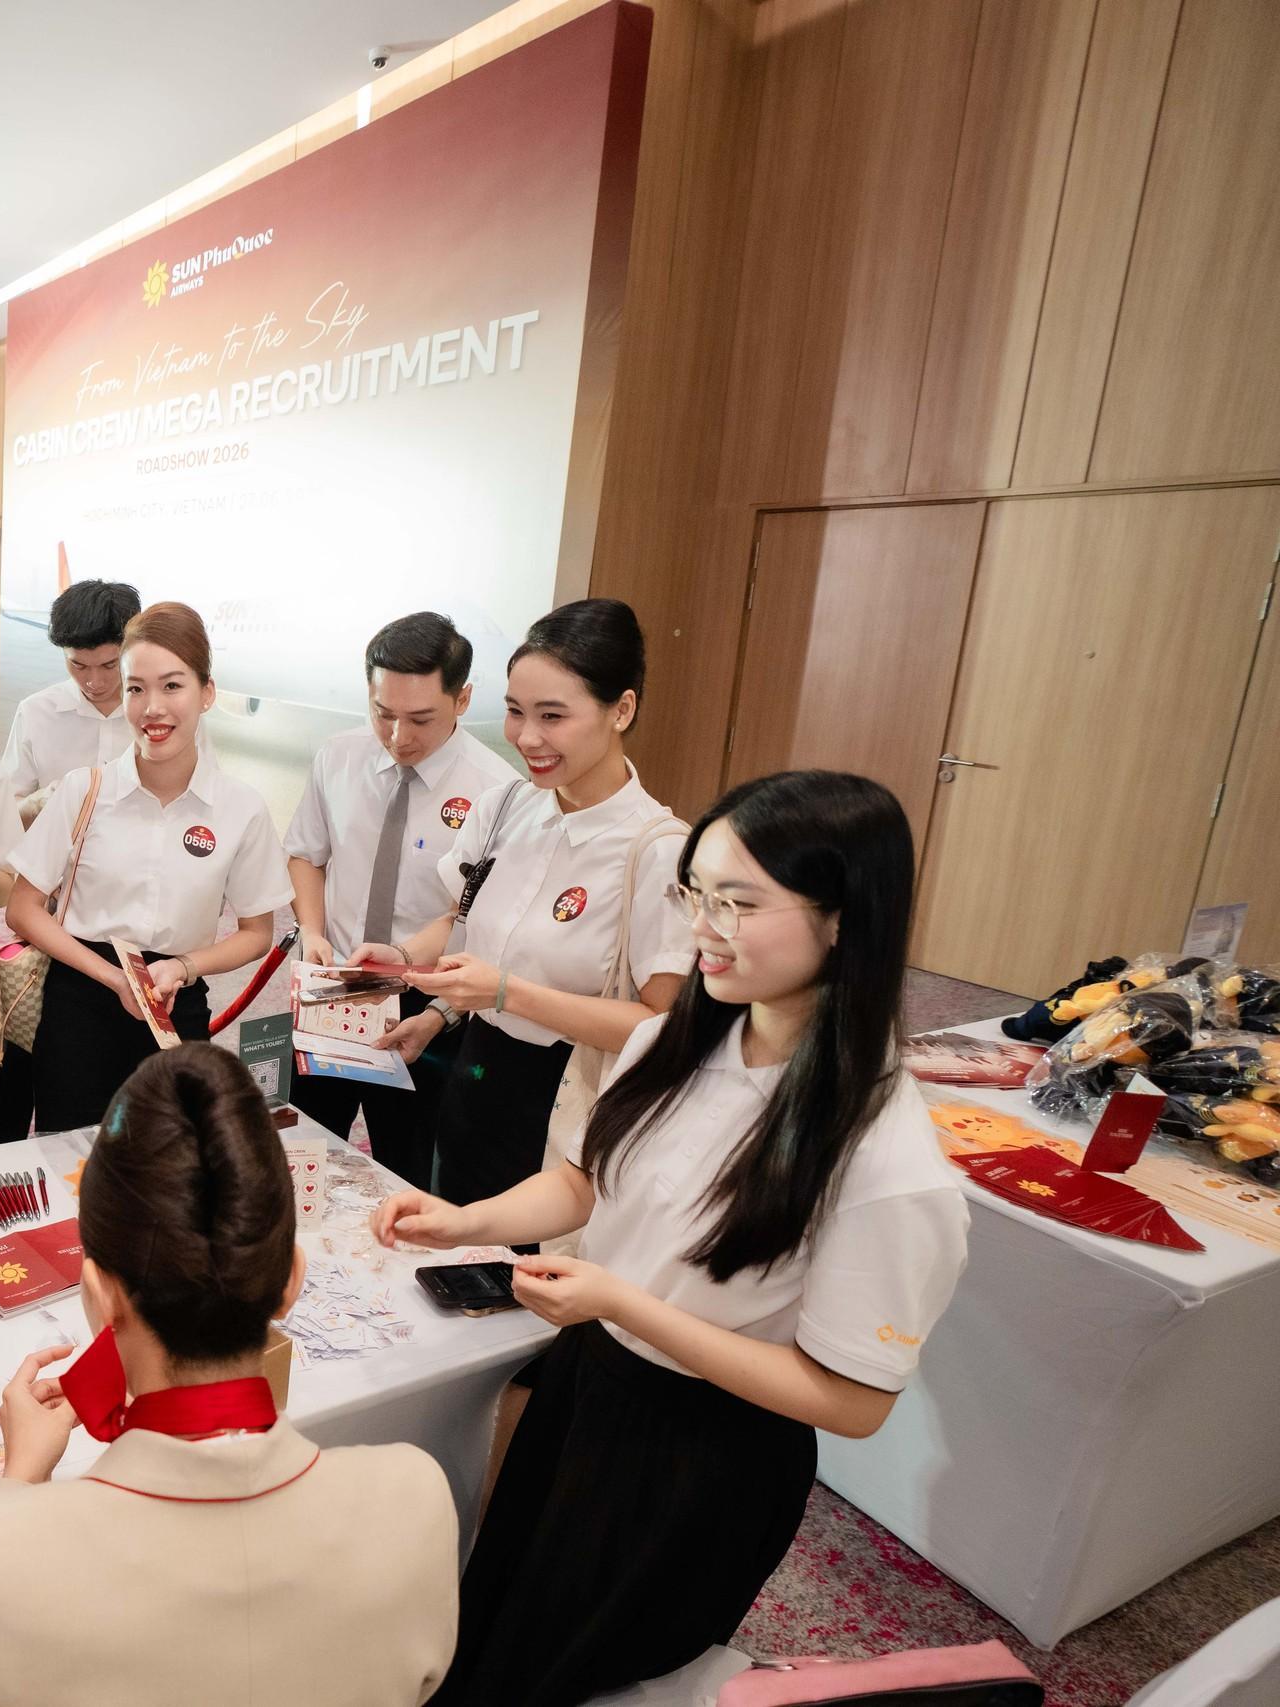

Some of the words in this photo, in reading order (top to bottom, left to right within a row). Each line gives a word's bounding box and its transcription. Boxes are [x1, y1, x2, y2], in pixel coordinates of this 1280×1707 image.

[171, 254, 201, 284] SUN
[202, 228, 274, 272] PhuQuoc
[170, 275, 204, 298] AIRWAYS
[76, 360, 126, 412] From
[133, 341, 214, 396] Vietnam
[216, 322, 246, 376] to
[246, 311, 291, 368] the
[299, 281, 369, 349] Sky
[12, 425, 69, 467] CABIN
[70, 408, 141, 456] CREW
[142, 387, 224, 438] MEGA
[230, 309, 540, 425] RECRUITMENT
[136, 447, 210, 476] ROADSHOW
[212, 441, 250, 465] 2026
[442, 807, 467, 820] 059
[184, 833, 215, 851] 0585
[557, 896, 579, 915] 234
[243, 1043, 265, 1053] WHAT'S
[265, 1039, 286, 1048] YOURS?
